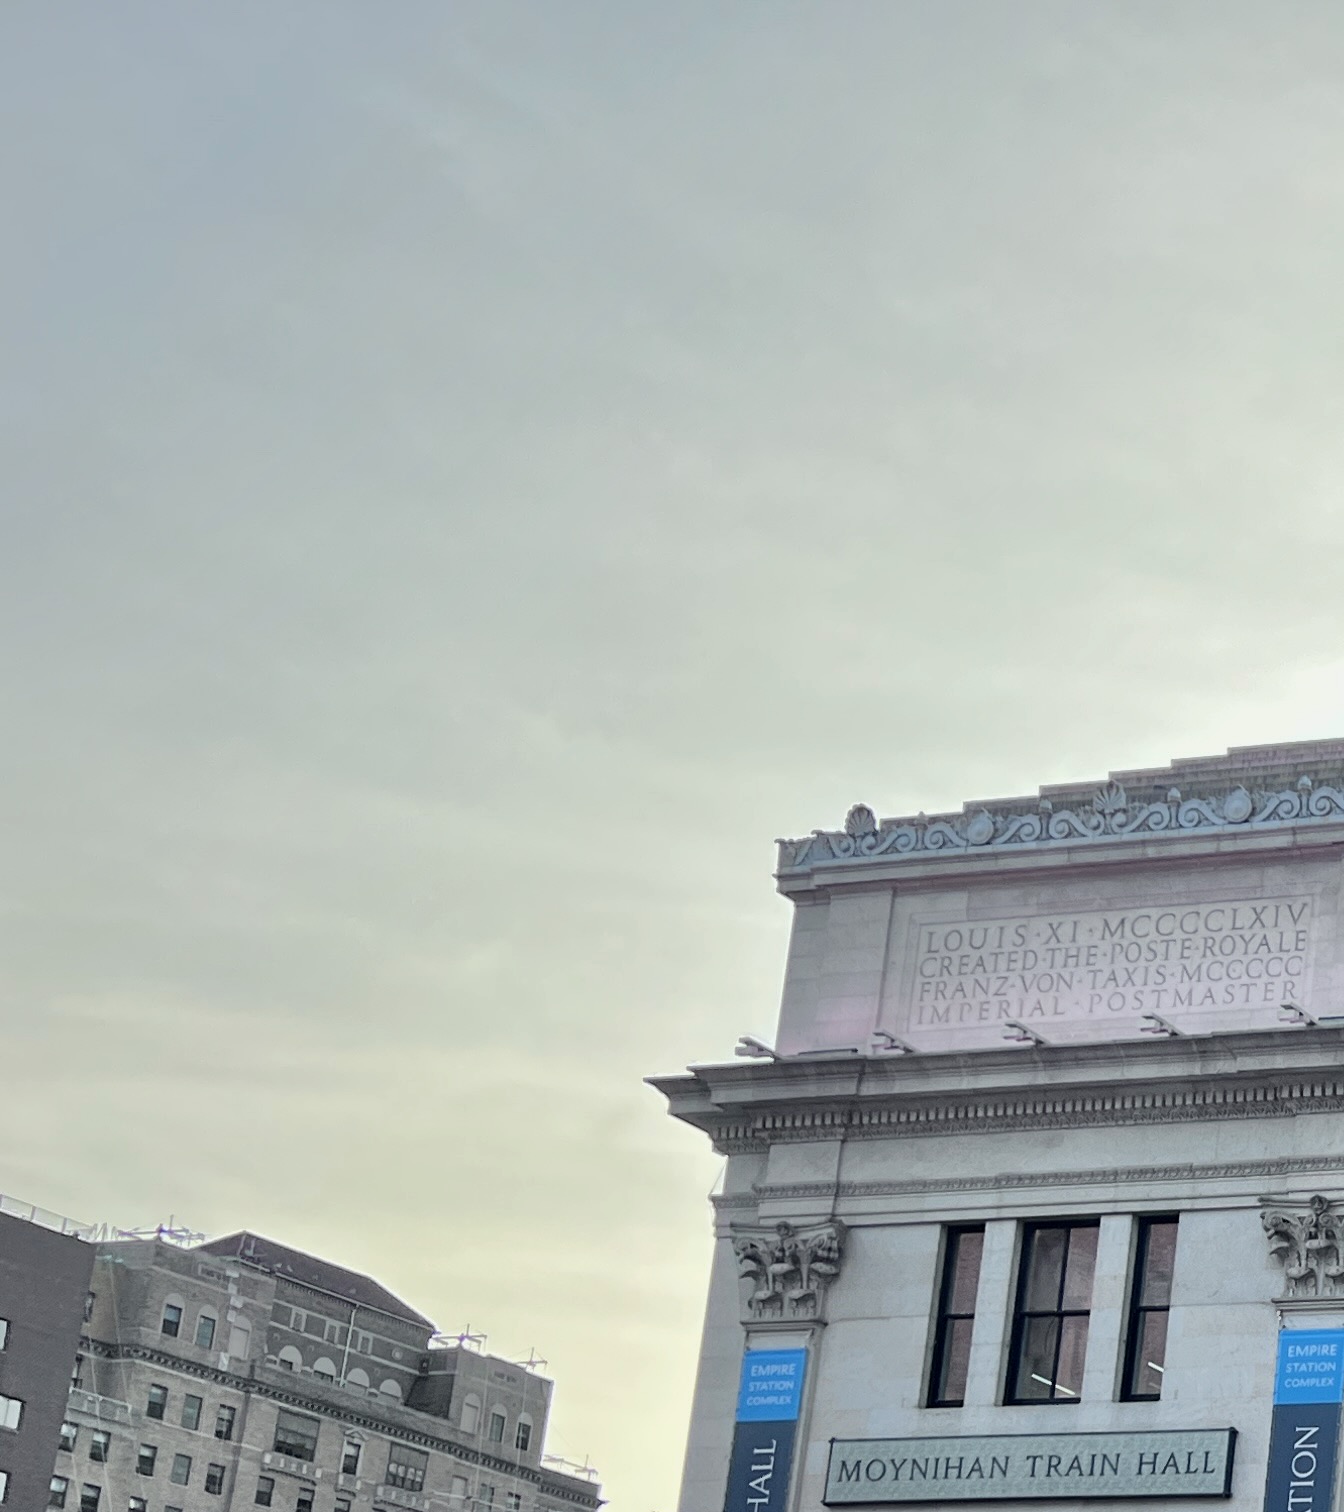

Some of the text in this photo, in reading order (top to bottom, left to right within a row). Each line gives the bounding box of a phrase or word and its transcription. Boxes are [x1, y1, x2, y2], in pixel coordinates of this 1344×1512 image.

[926, 902, 1309, 954] LOUIS XI MCCCCLXIV
[919, 930, 1307, 979] CREATED THE POSTE ROYALE
[919, 955, 1303, 1001] FRANZ VON TAXIS MCCCCC
[916, 981, 1297, 1026] IMPERIAL POSTMASTER
[1287, 1343, 1338, 1358] EMPIRE
[751, 1363, 797, 1377] EMPIRE
[1285, 1361, 1337, 1373] STATION
[748, 1380, 795, 1392] STATION
[1284, 1377, 1335, 1388] COMPLEX
[746, 1395, 792, 1406] COMPLEX
[837, 1450, 1216, 1483] MOYNIHAN TRAIN HALL
